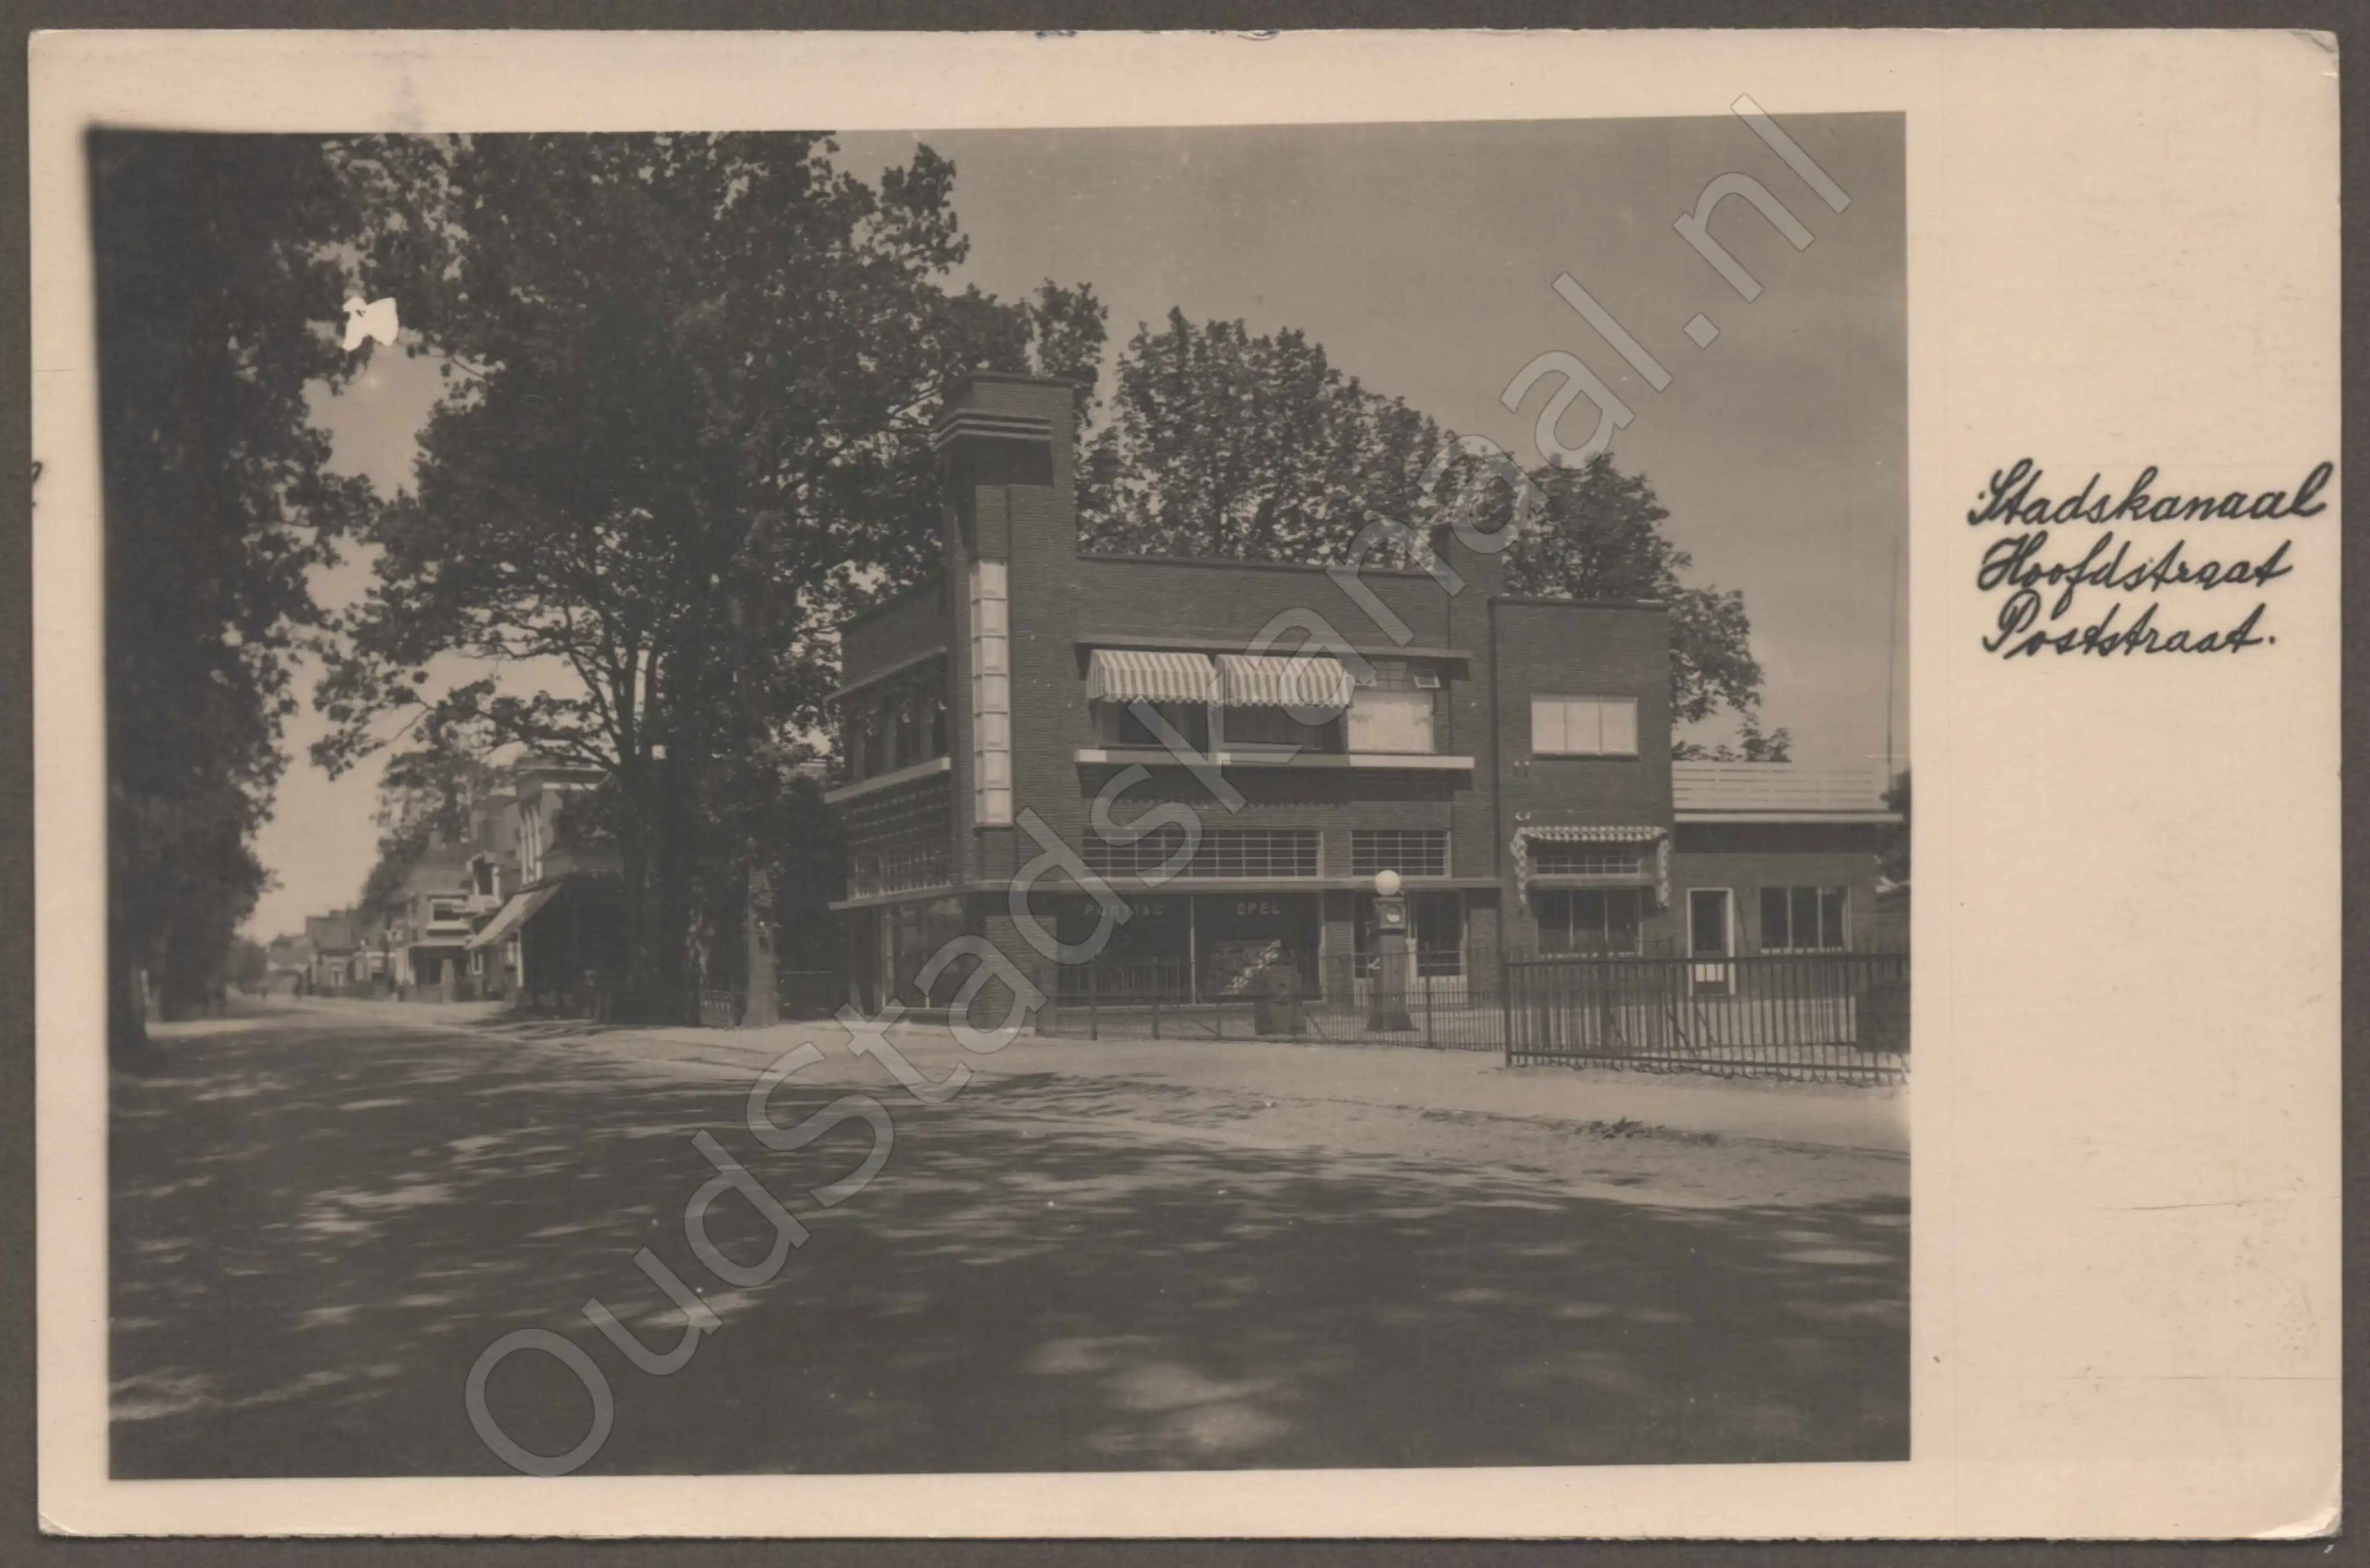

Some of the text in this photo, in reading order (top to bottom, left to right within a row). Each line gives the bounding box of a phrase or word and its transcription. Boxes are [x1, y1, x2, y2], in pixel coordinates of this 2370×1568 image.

[1967, 458, 2334, 525] Stadskanaal
[1978, 530, 2294, 620] Hoofdstraat
[1236, 902, 1280, 915] OPEL
